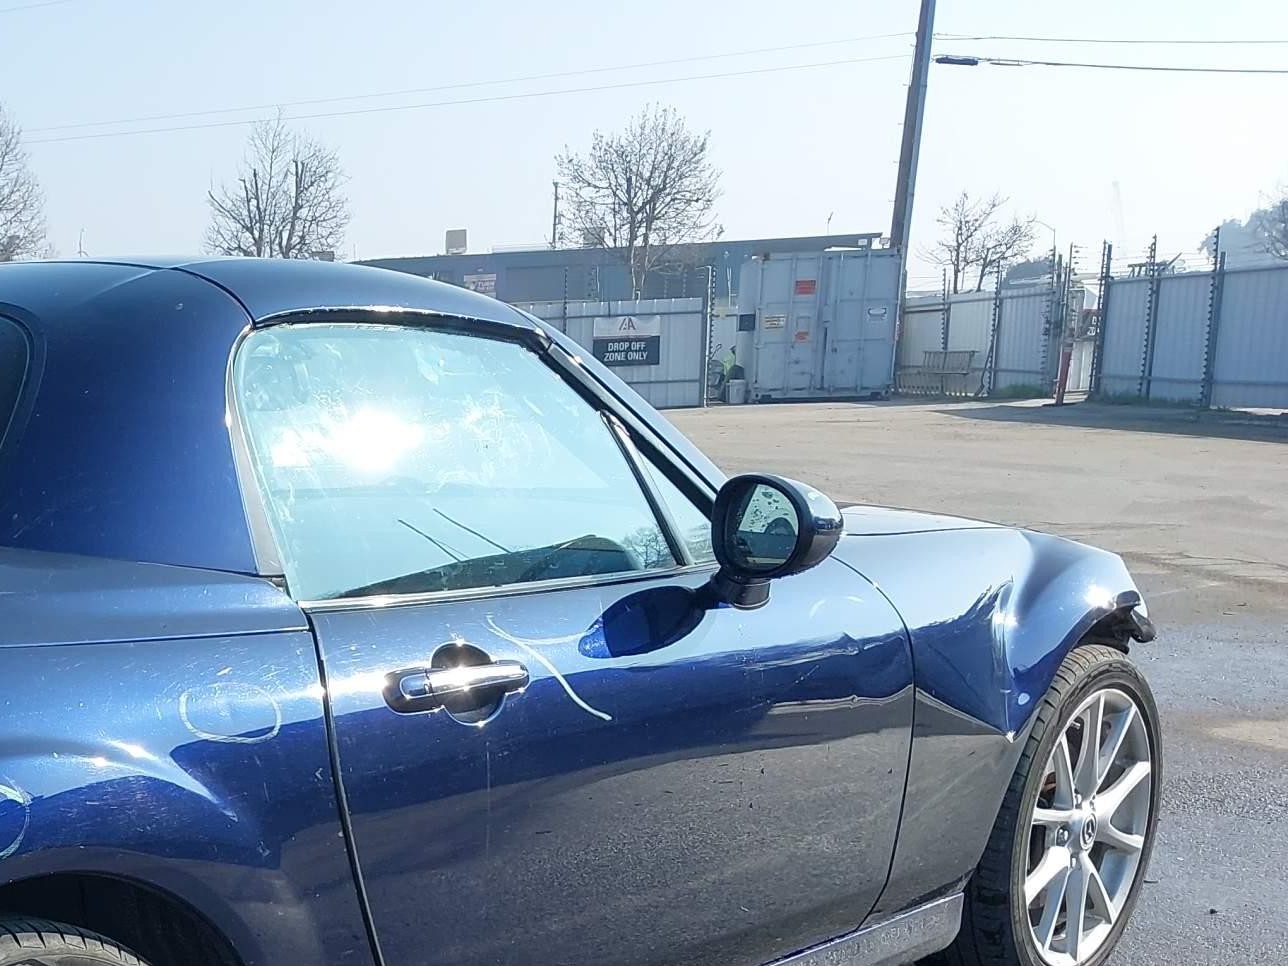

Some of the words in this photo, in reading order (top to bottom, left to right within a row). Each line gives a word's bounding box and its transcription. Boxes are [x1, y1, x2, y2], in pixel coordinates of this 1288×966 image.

[608, 342, 629, 351] DROP
[631, 341, 646, 350] OFF
[604, 352, 626, 361] ZONE
[627, 351, 648, 360] ONLY
